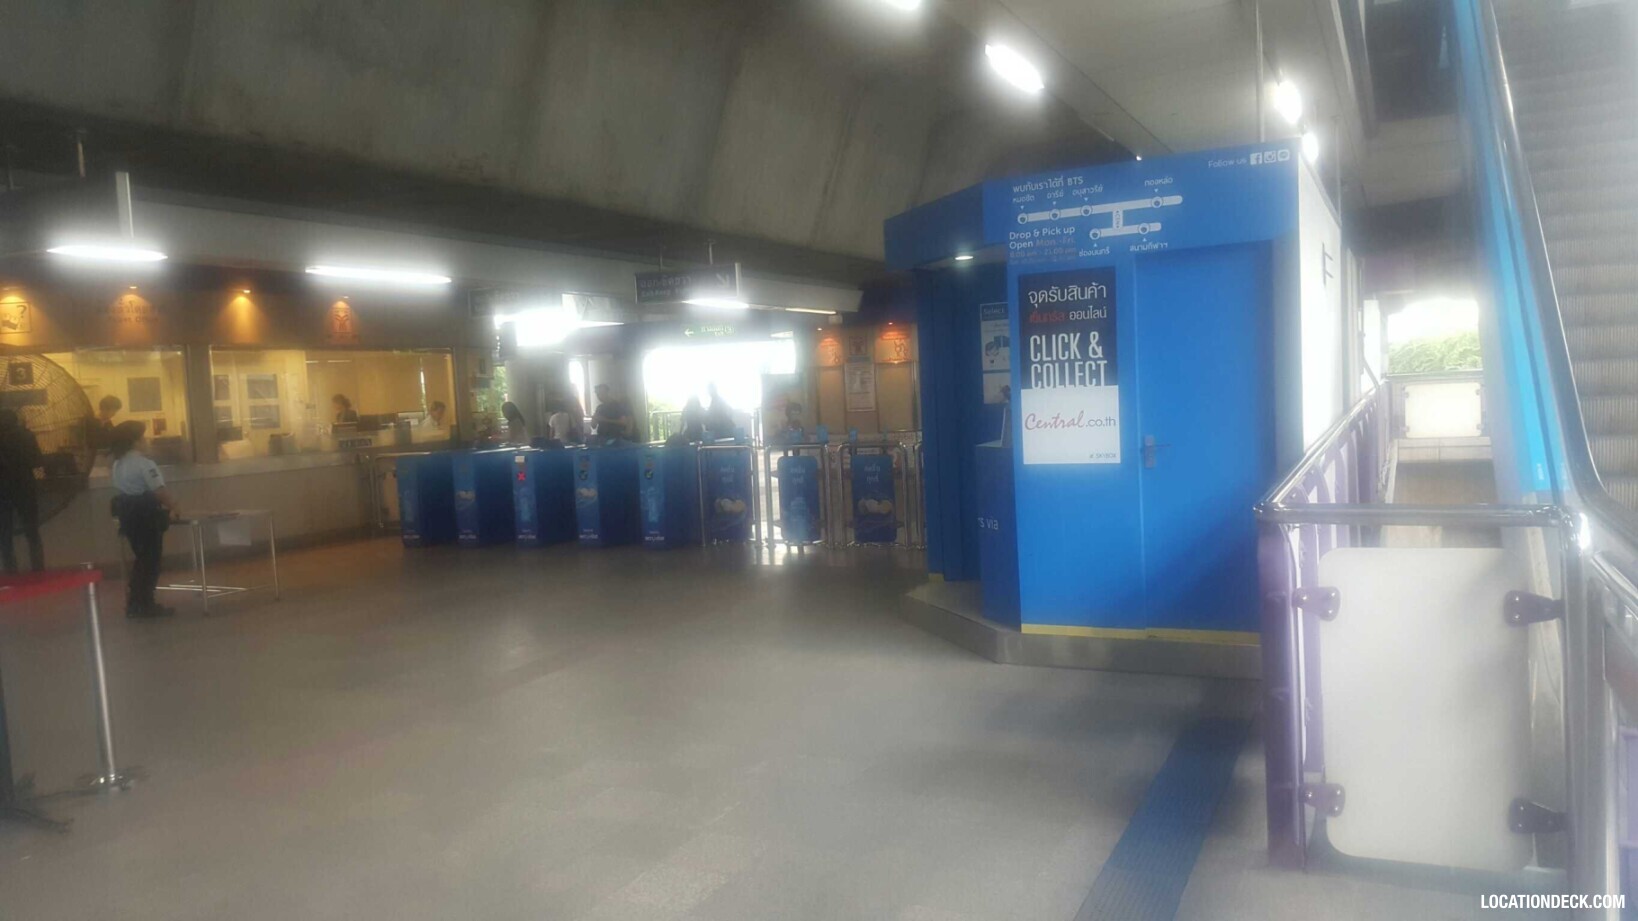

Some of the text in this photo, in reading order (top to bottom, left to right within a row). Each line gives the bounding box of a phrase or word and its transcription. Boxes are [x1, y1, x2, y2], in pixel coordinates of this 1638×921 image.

[1067, 176, 1084, 186] BTS
[1009, 226, 1075, 242] Drop & Pick up
[1009, 240, 1033, 250] Open
[1028, 282, 1107, 308] จุดรับสินค้า
[1069, 305, 1107, 321] ออนไลน์
[1029, 331, 1104, 362] CLICK &
[1031, 360, 1108, 389] COLLECT
[1025, 410, 1117, 431] Central.co.th
